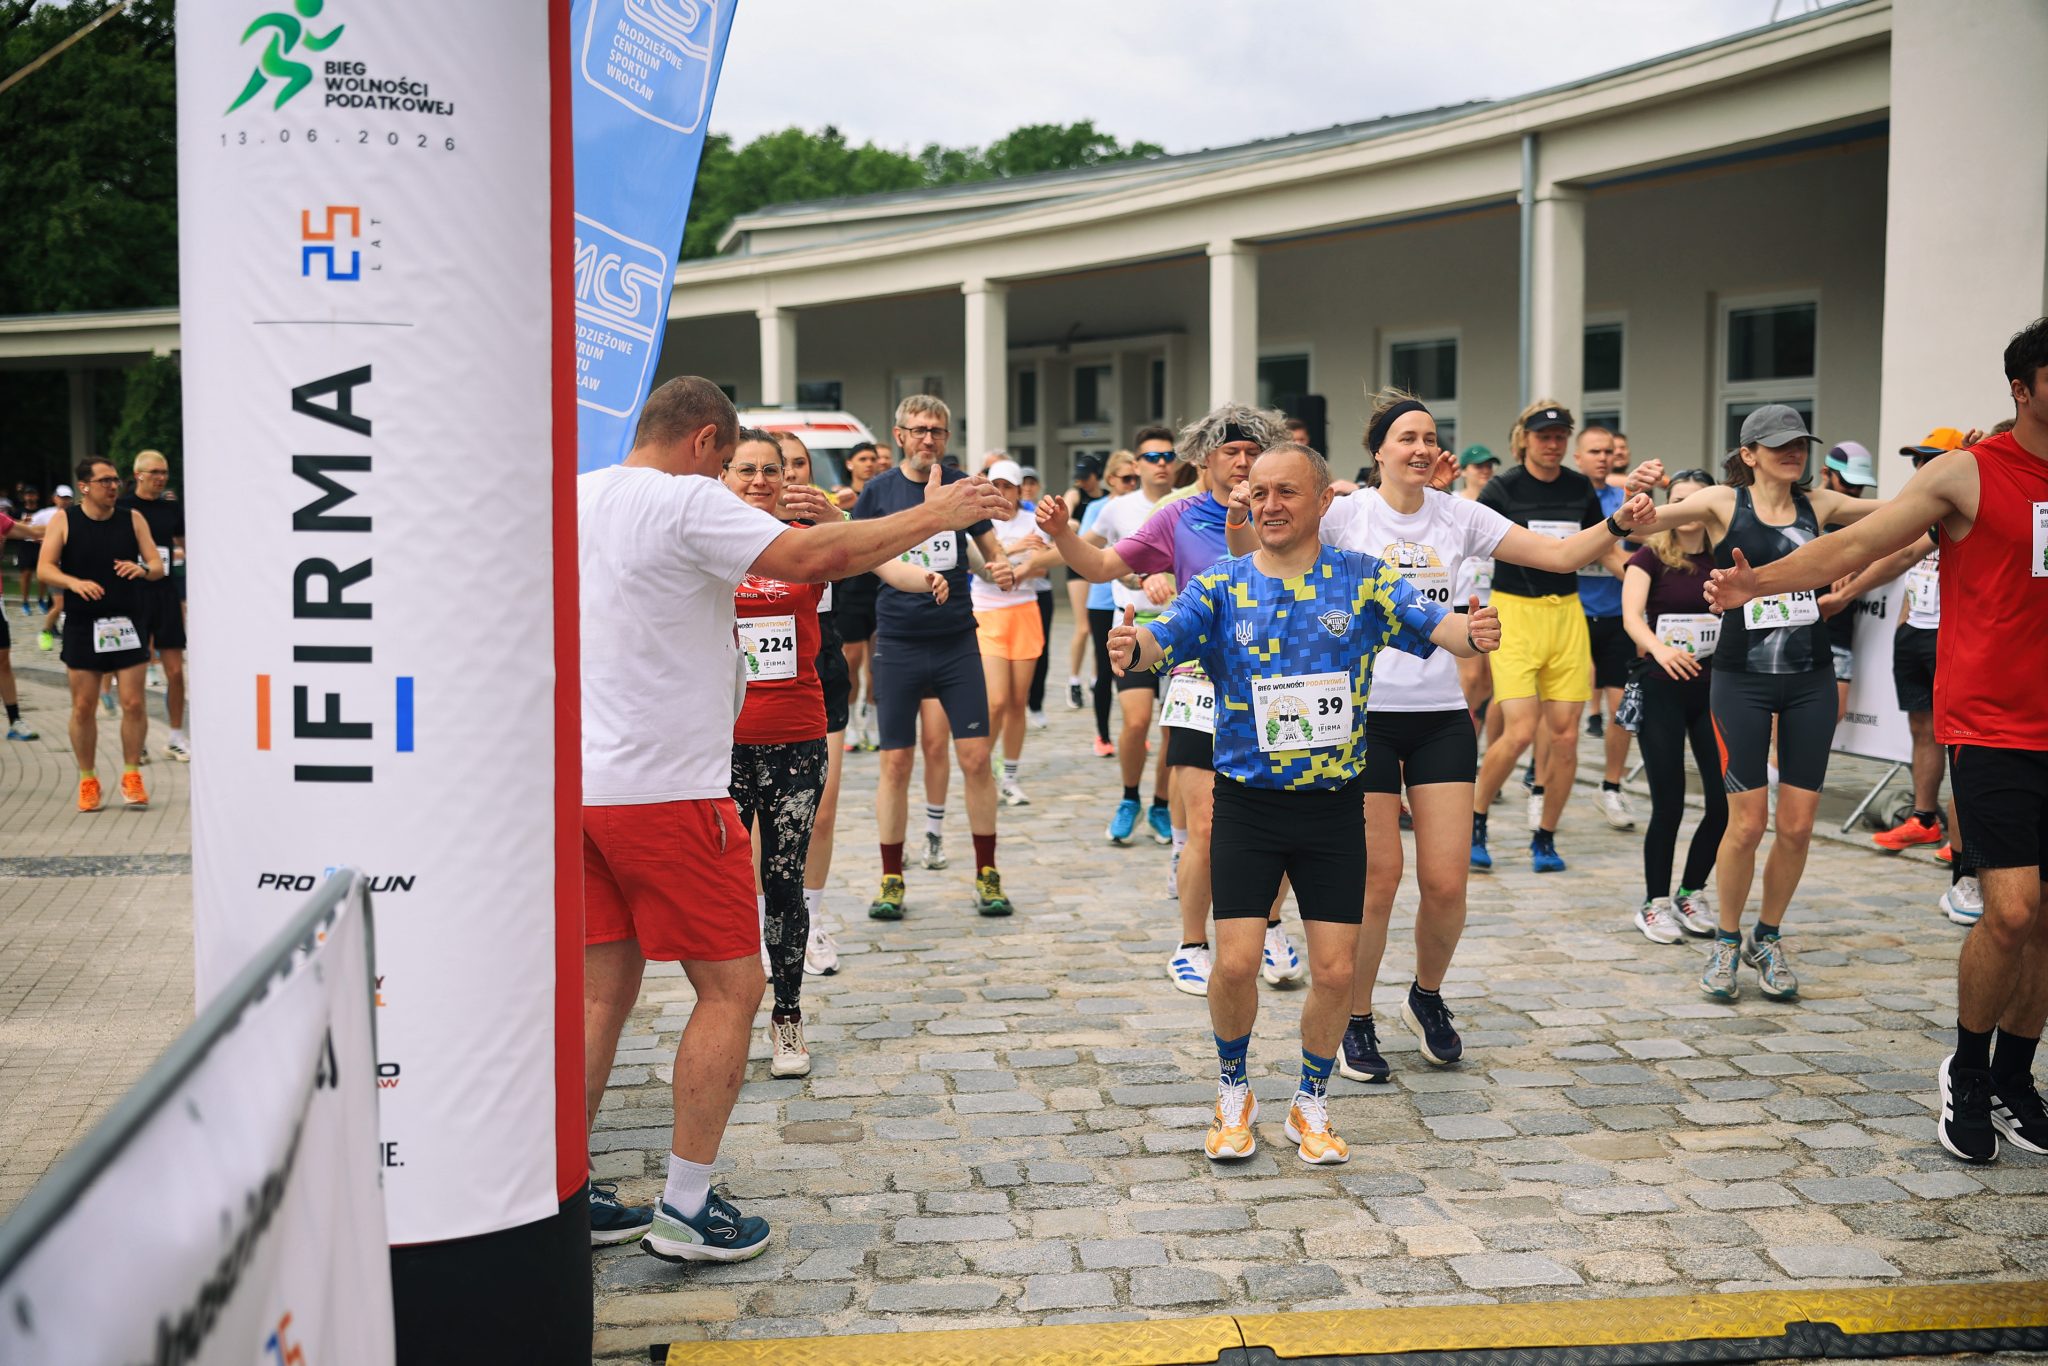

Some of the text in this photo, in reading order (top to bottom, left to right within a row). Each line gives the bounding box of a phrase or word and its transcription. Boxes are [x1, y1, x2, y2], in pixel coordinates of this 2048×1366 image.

[613, 34, 661, 71] CENTRUM
[617, 18, 684, 71] MŁODZIEŻOWE
[325, 61, 367, 76] BIEG
[609, 48, 648, 80] SPORTU
[325, 76, 428, 97] WOLNOŚCI
[606, 63, 654, 101] WROCŁAW
[325, 94, 454, 116] PODATKOWEJ
[370, 219, 382, 271] LAT
[933, 540, 950, 552] 59
[292, 364, 373, 783] IFIRMA
[759, 636, 793, 653] 224
[1701, 630, 1716, 642] 111
[1257, 684, 1271, 692] BIEG
[1273, 680, 1305, 690] WOLNOŚCI
[1318, 696, 1343, 716] 39
[1318, 724, 1341, 732] IFIRMA
[257, 873, 316, 892] PRO
